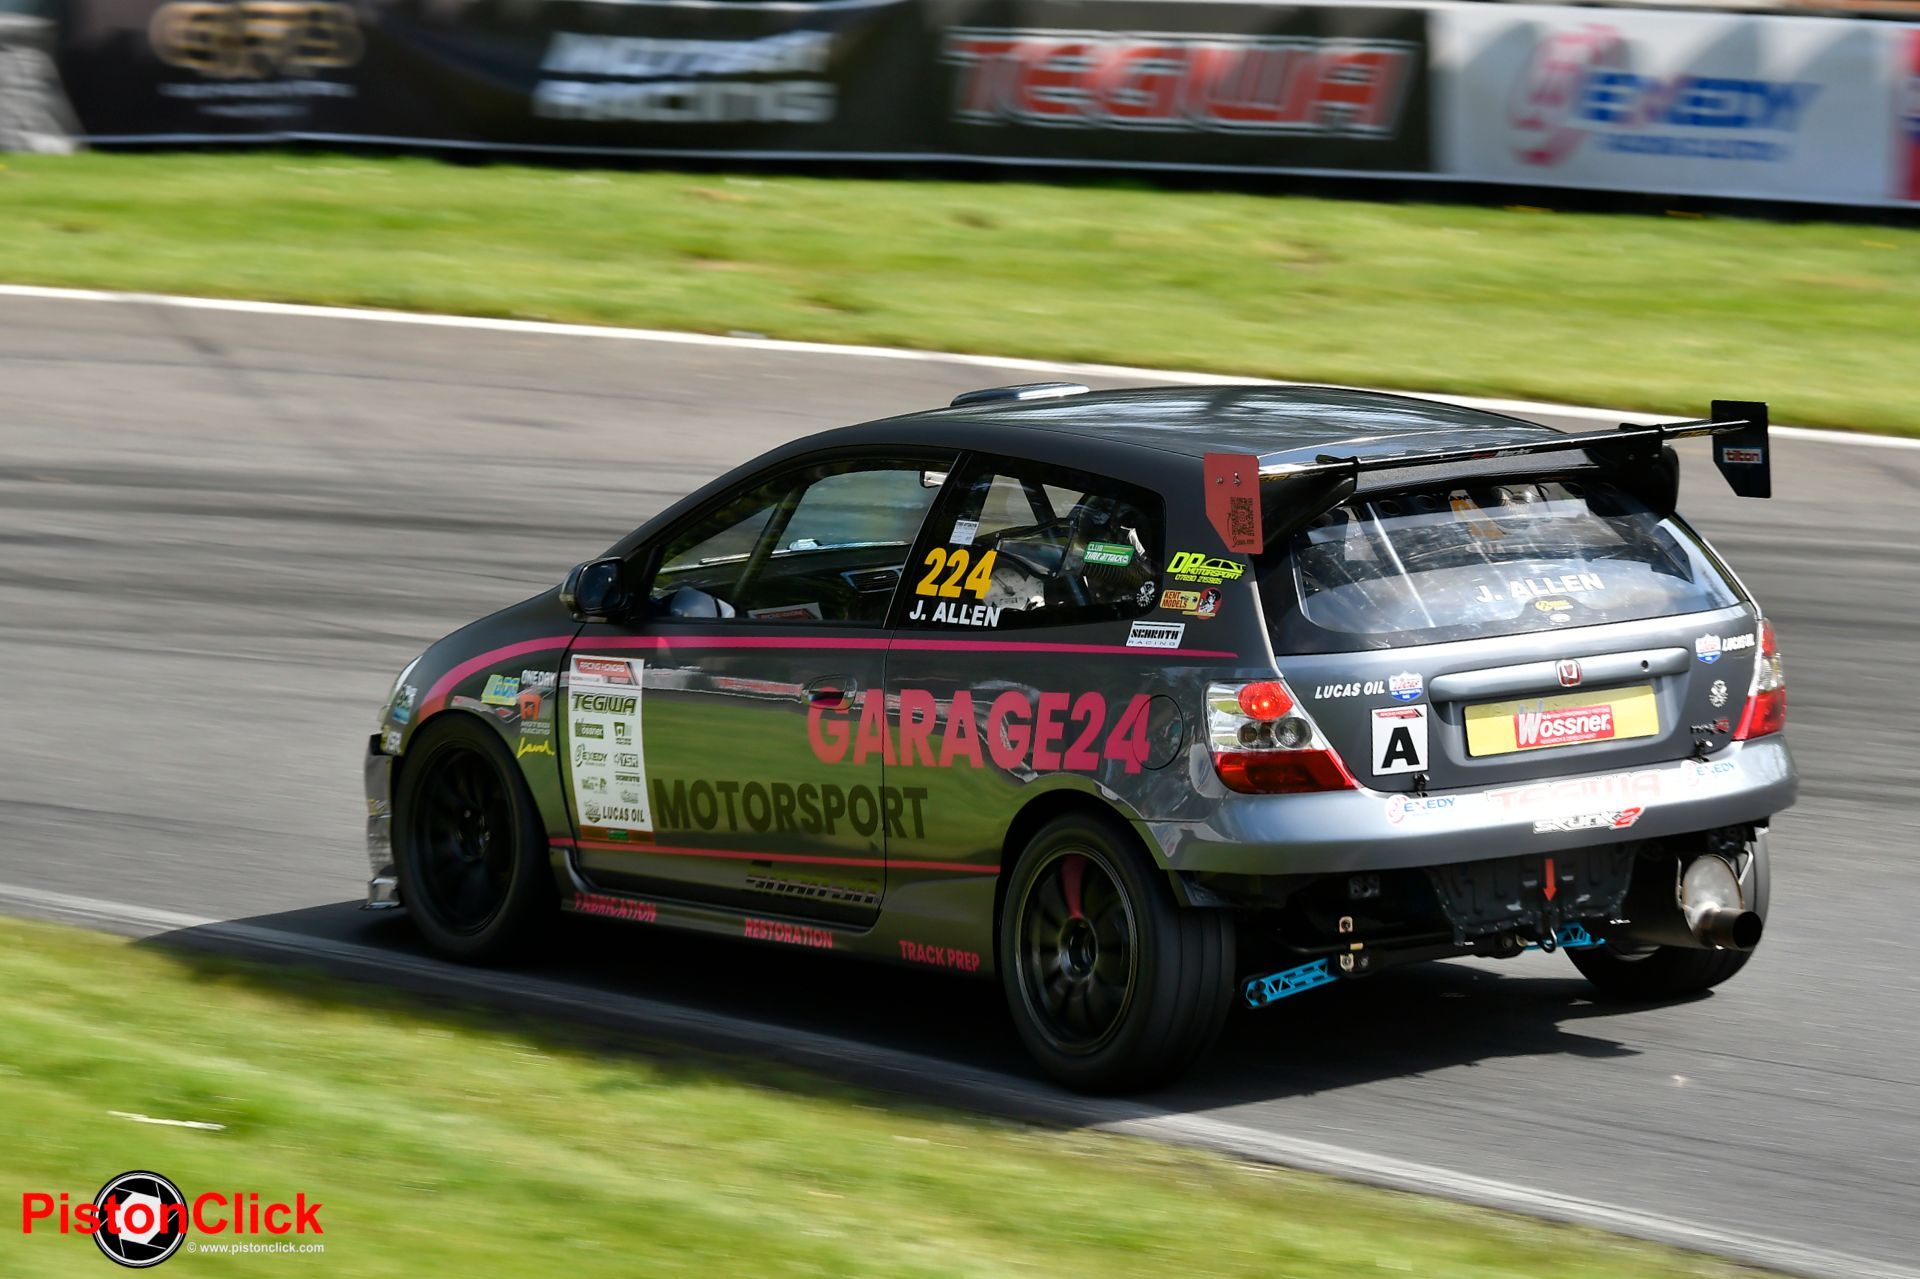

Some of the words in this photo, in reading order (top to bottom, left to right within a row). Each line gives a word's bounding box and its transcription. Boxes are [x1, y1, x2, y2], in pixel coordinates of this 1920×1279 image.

[915, 548, 998, 599] 224
[1166, 552, 1205, 573] DP
[1185, 566, 1242, 580] MOTORSPORT
[1164, 591, 1181, 601] KENT
[1476, 585, 1504, 603] J.
[1510, 573, 1605, 599] ALLEN
[909, 600, 926, 620] J.
[932, 602, 1000, 627] ALLEN
[1161, 599, 1188, 608] MODELS
[571, 691, 638, 716] TEGIWA
[1315, 683, 1362, 699] LUCAS
[1363, 681, 1385, 695] OIL
[807, 687, 1152, 774] GARAGE24
[1381, 726, 1420, 768] A
[602, 806, 630, 821] LUCAS
[631, 809, 645, 823] OIL
[653, 778, 929, 839] MOTORSPORT
[574, 891, 657, 922] FABRICATION
[743, 918, 833, 949] RESTORATION
[900, 940, 944, 966] TRACK
[948, 947, 980, 972] PREP
